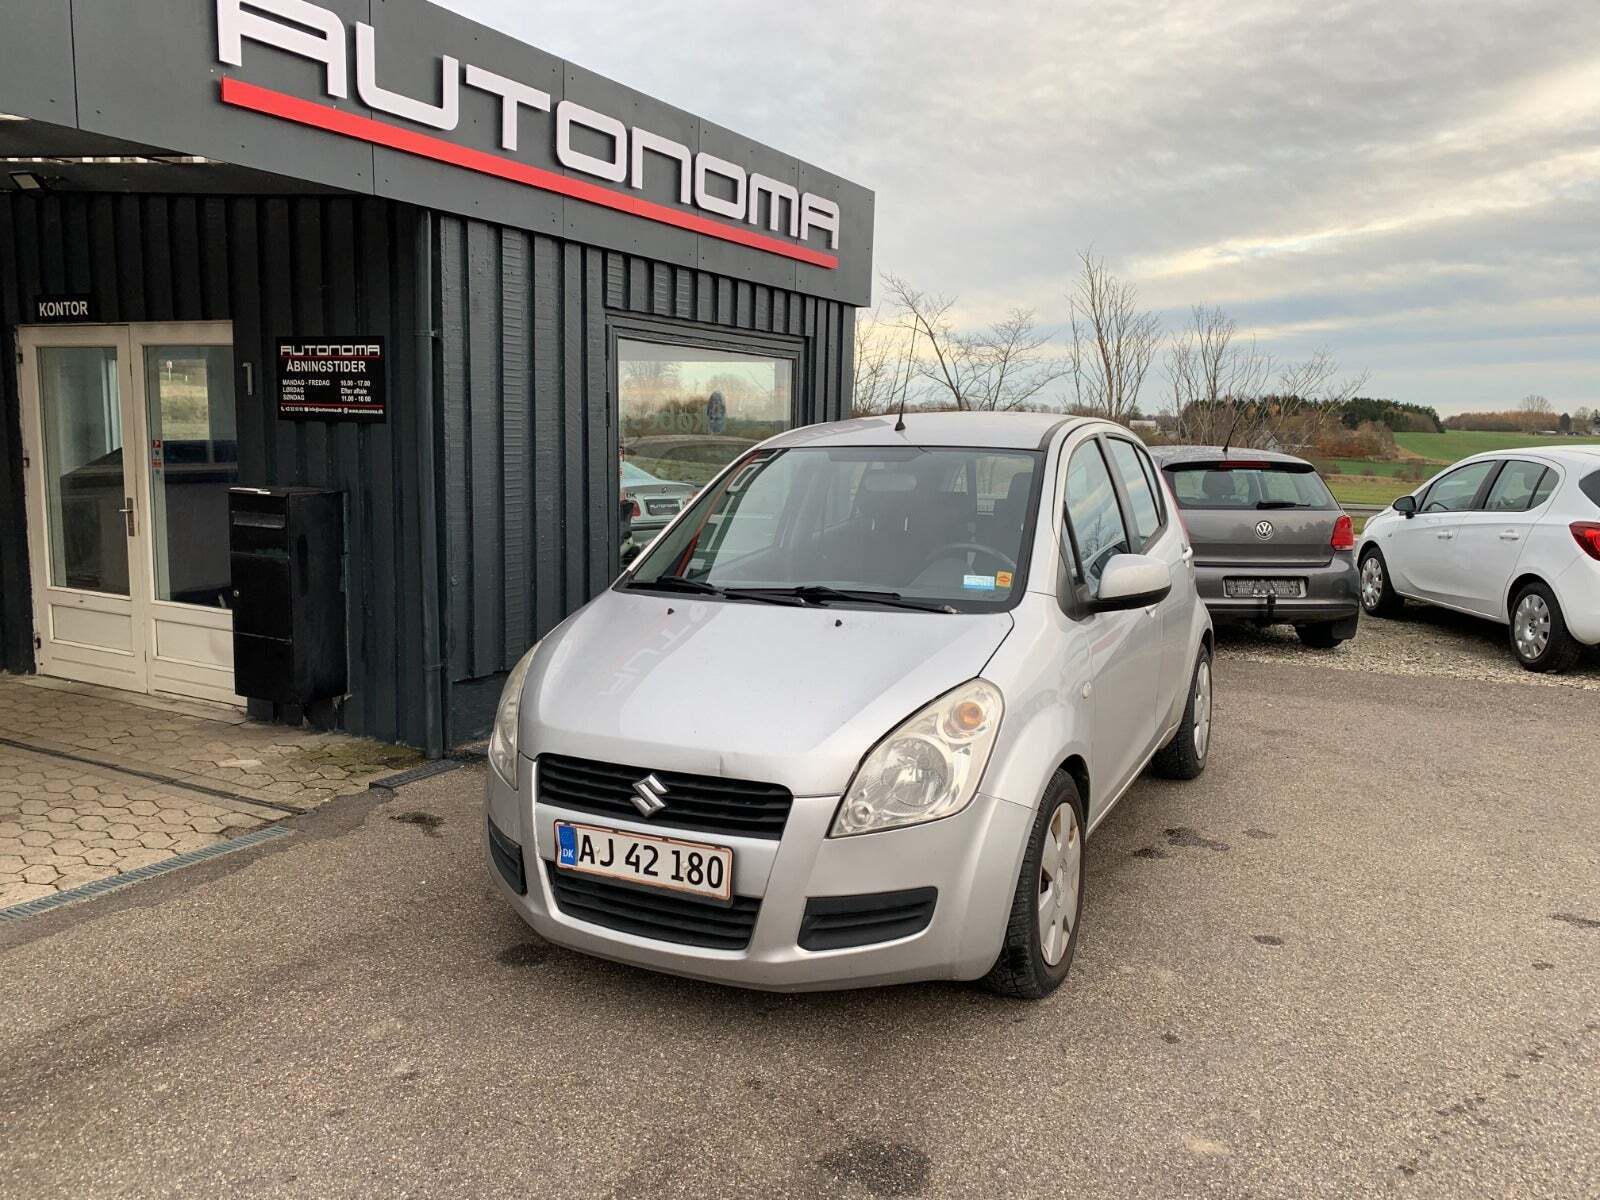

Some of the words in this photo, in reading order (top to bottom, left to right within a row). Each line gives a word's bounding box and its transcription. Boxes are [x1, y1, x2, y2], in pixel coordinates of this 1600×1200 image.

[217, 0, 840, 250] AUTONOMA
[38, 300, 89, 317] KONTOR
[280, 344, 381, 356] AUTONOMA
[286, 359, 366, 373] ÅBNINGSTIDER
[561, 848, 574, 859] DK
[578, 834, 614, 867] AJ
[625, 842, 659, 877] 42
[671, 850, 724, 889] 180
